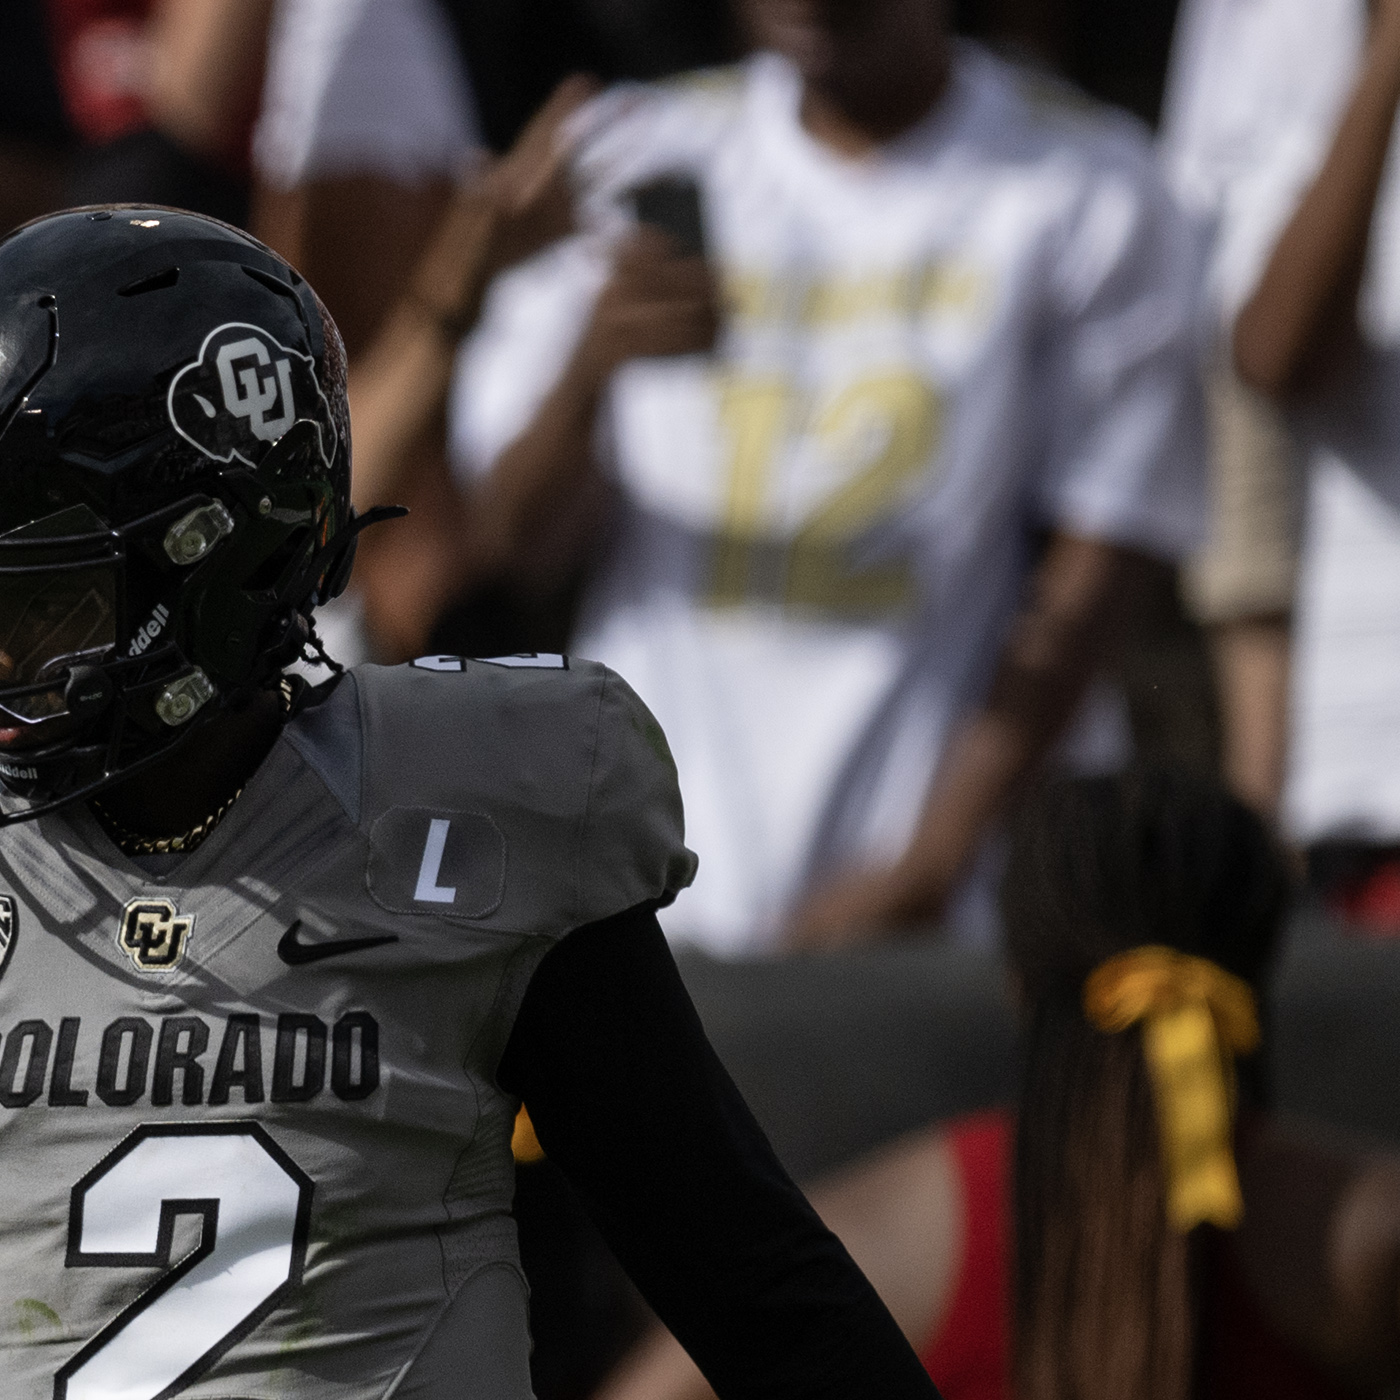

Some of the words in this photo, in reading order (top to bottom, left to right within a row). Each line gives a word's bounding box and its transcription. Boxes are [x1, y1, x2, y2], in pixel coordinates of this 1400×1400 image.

[707, 371, 947, 618] 12
[129, 603, 170, 657] ddell
[413, 818, 456, 903] L
[121, 899, 192, 970] CU
